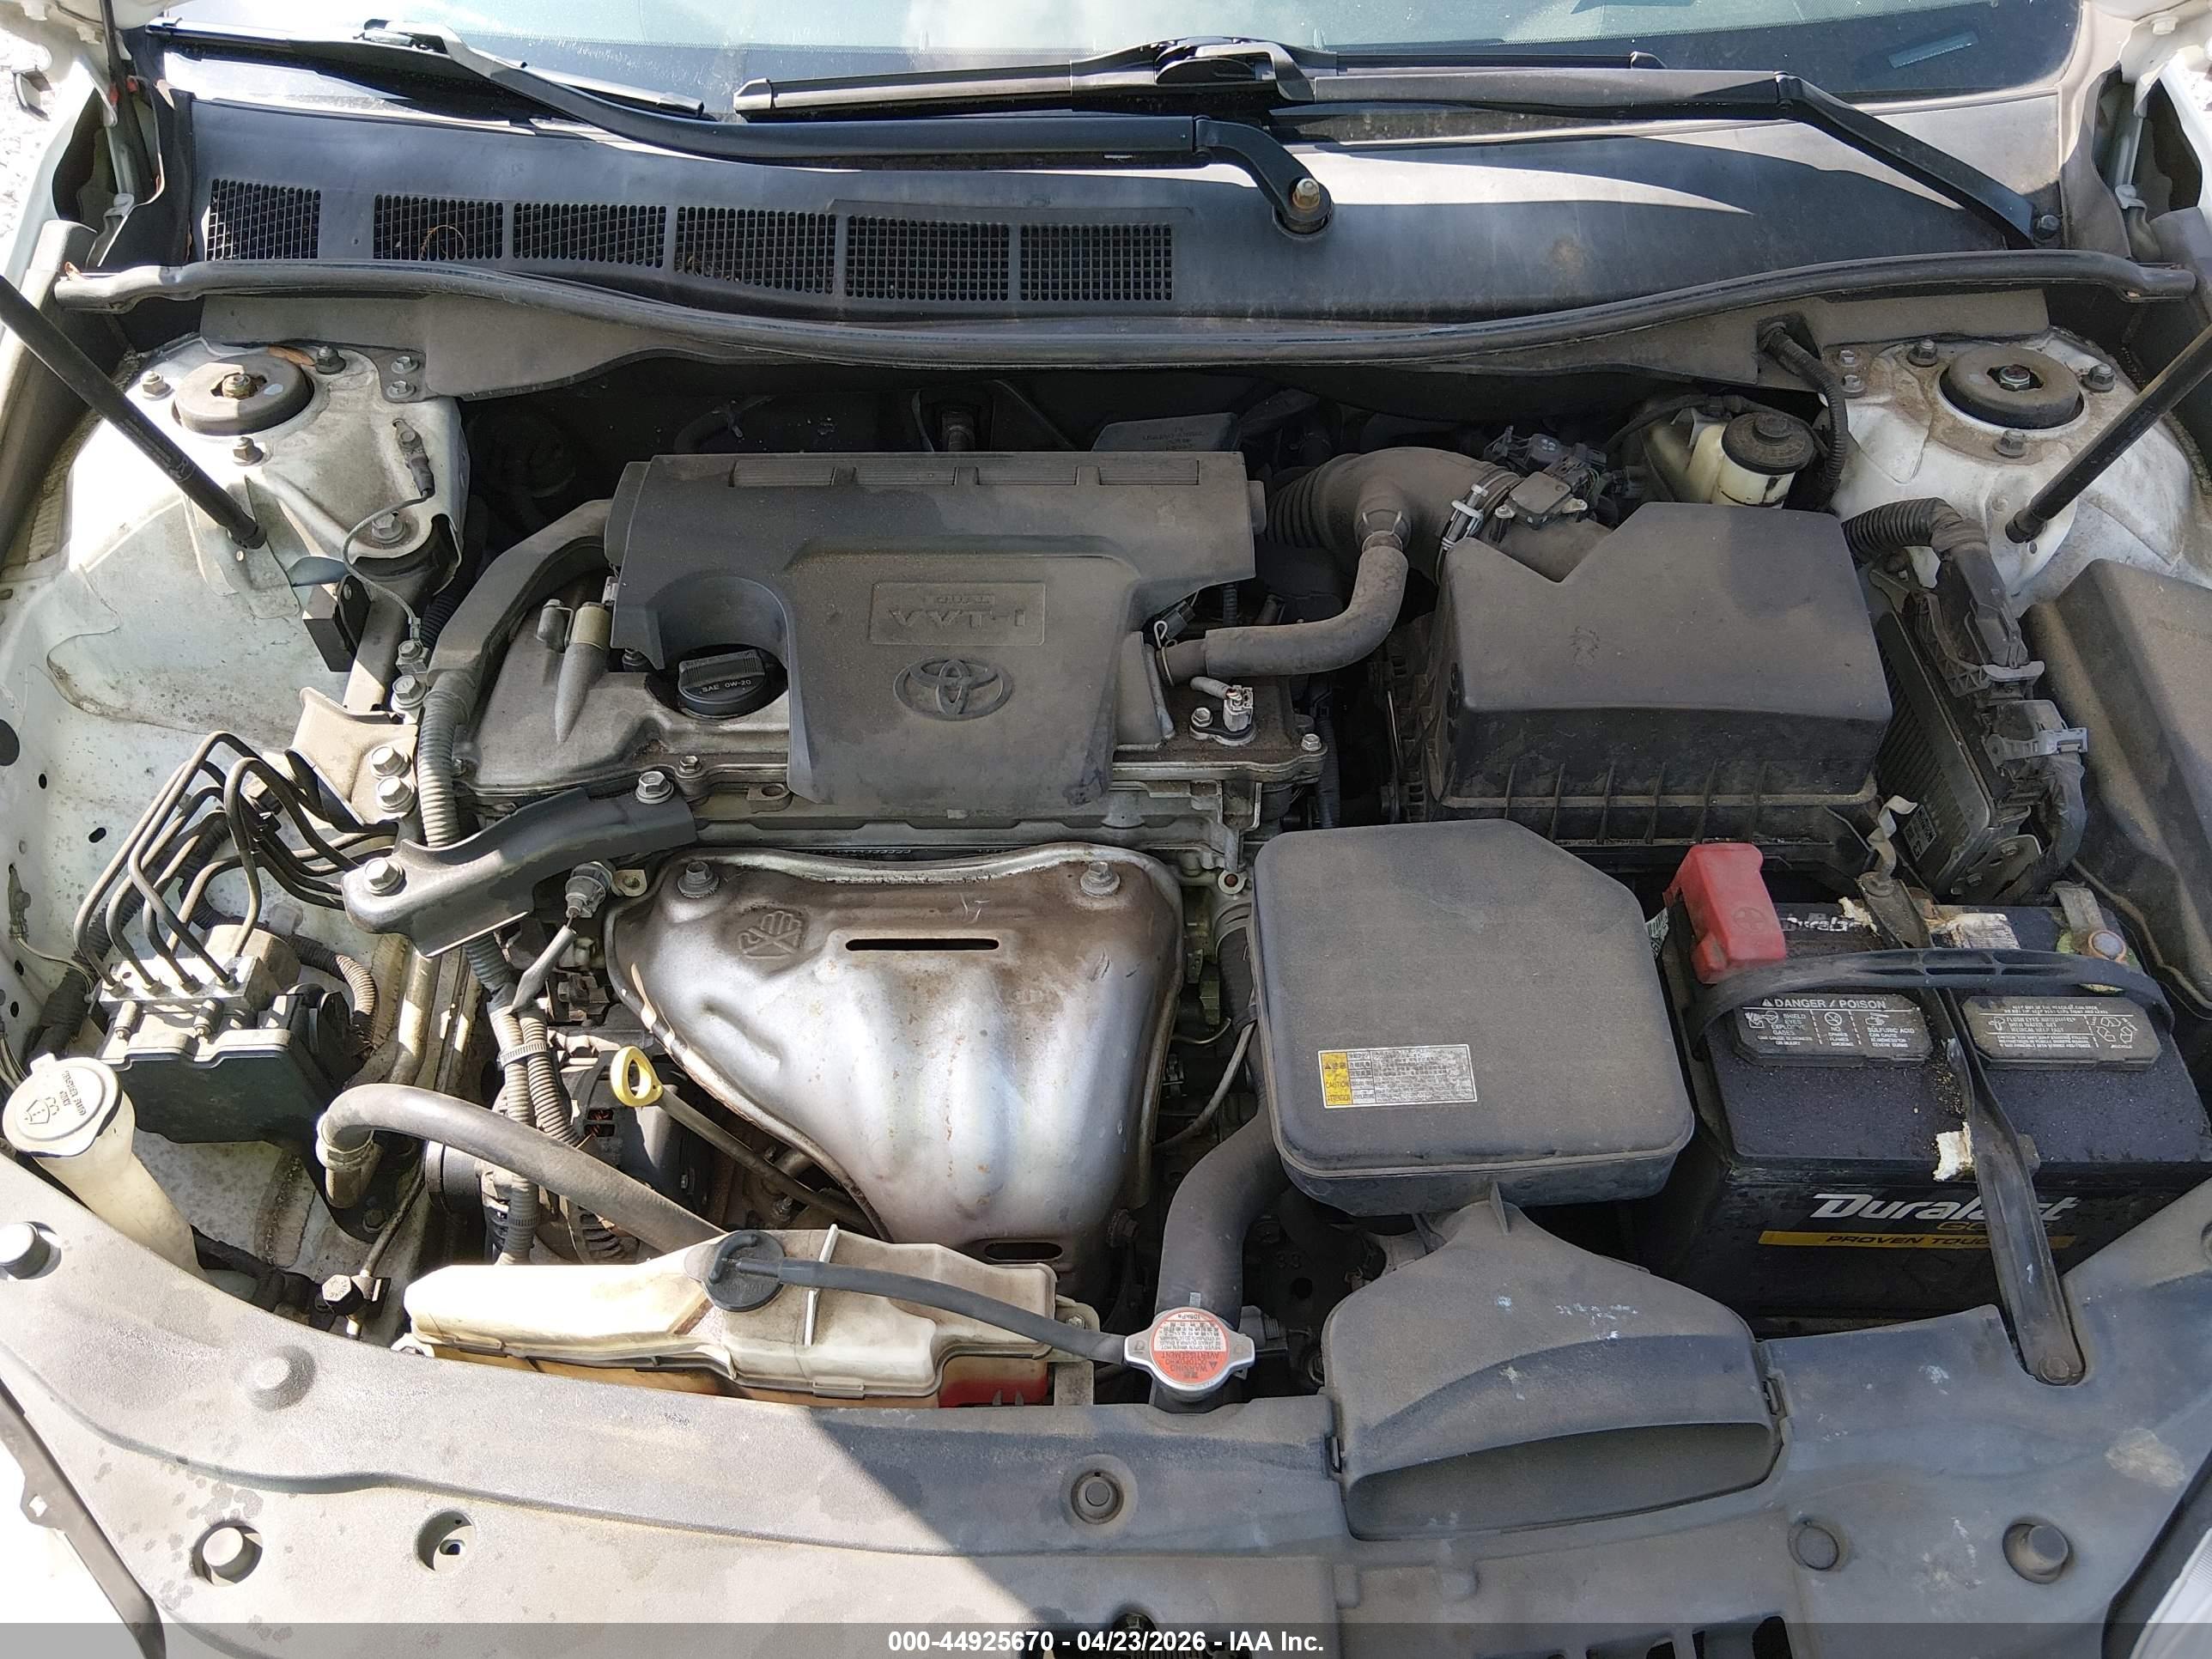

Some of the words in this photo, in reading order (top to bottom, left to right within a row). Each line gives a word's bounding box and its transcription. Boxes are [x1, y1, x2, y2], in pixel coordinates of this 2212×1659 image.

[702, 684, 720, 693] SAE
[724, 679, 752, 689] 0W-20
[1774, 999, 1826, 1008] DANGER
[1838, 1000, 1887, 1009] POISON
[1826, 1235, 1923, 1244] PROVEN
